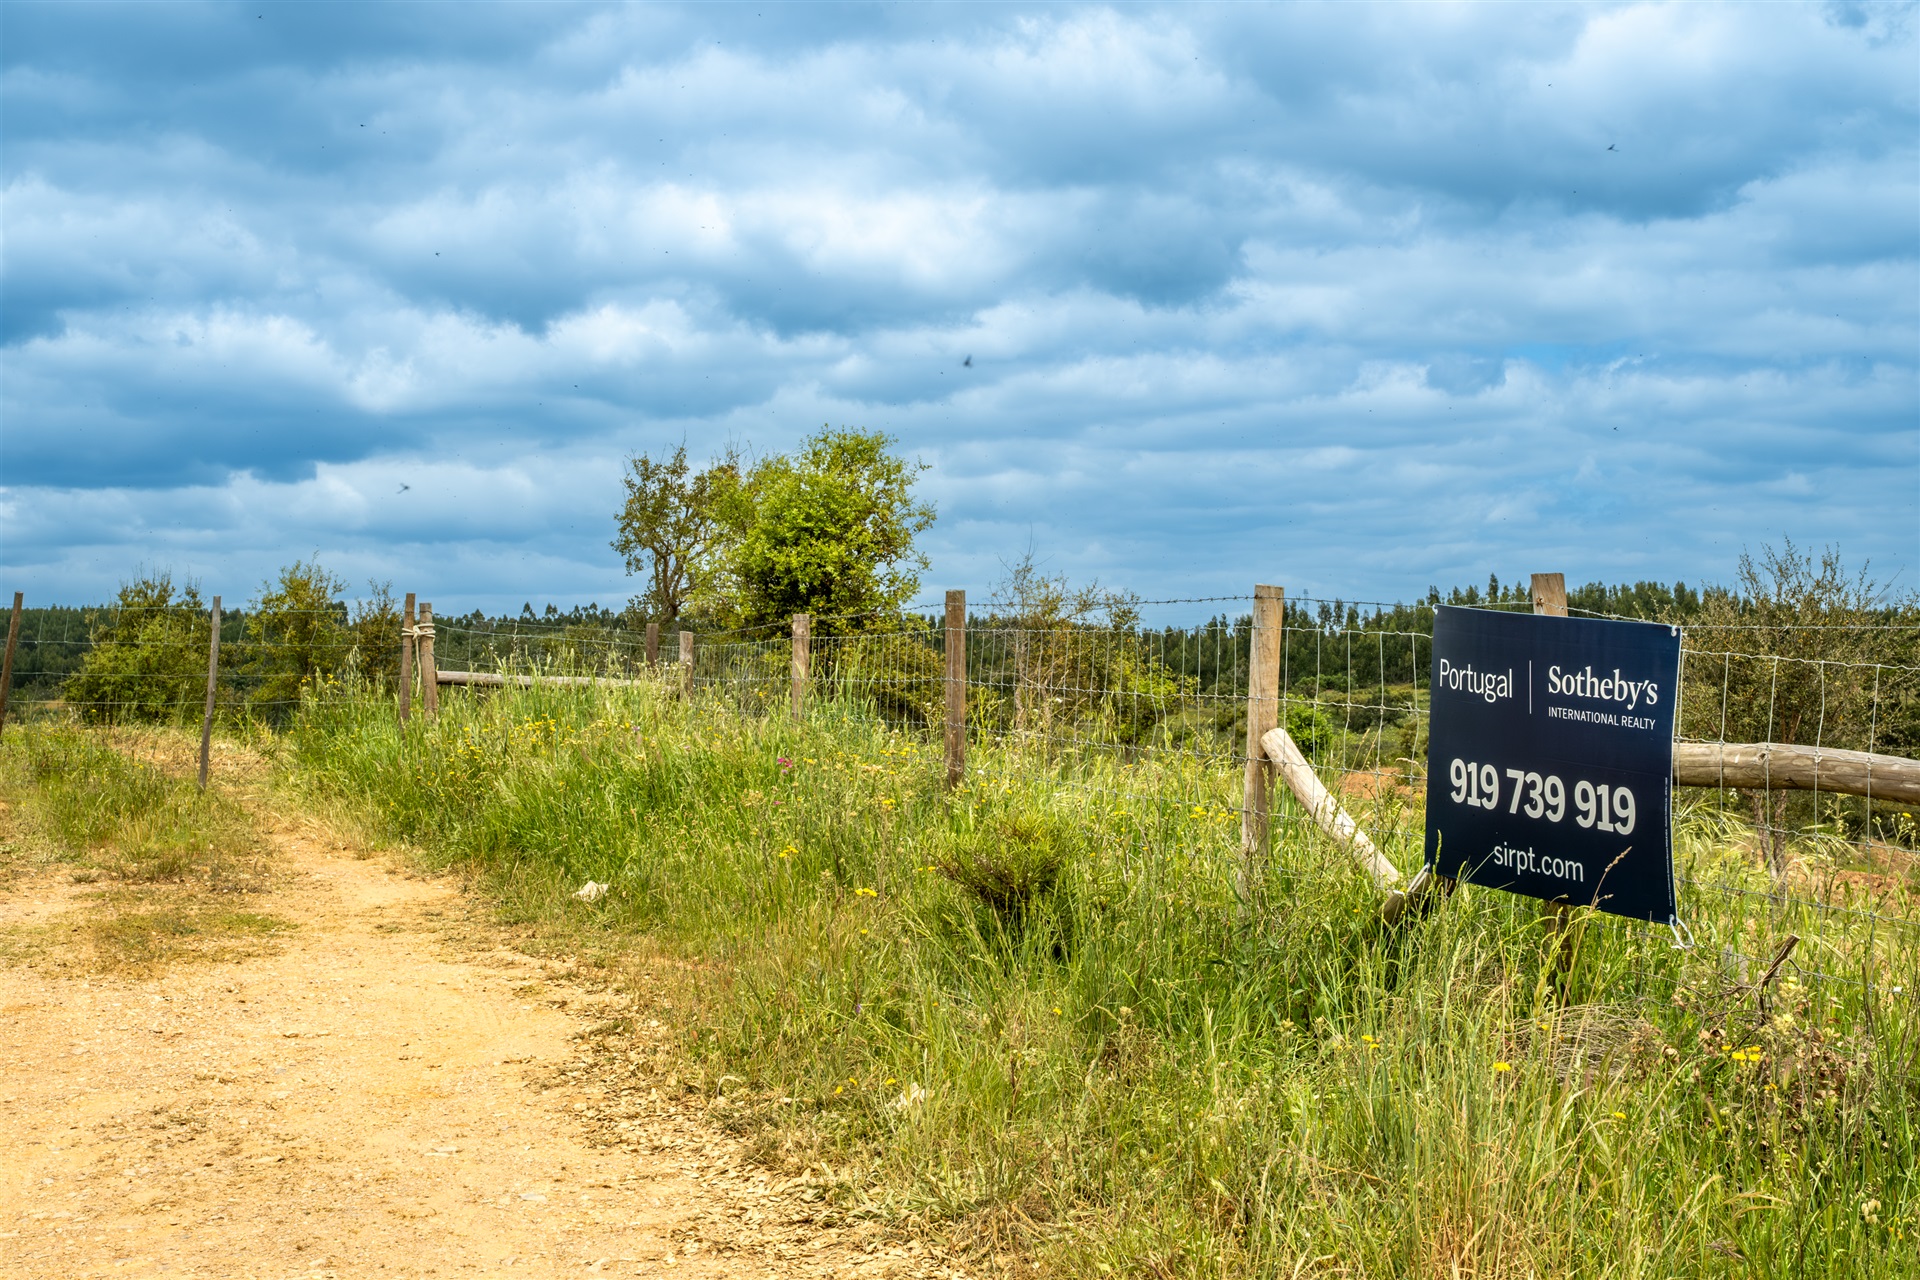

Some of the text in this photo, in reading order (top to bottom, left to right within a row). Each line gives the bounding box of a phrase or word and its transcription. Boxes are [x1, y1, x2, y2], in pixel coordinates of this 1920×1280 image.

[1440, 658, 1512, 703] Portugal
[1549, 666, 1658, 710] Sotheby's
[1548, 707, 1656, 730] INTERNATIONAL REALTY
[1450, 758, 1636, 835] 919 739 919
[1493, 842, 1584, 882] sirpt.com
